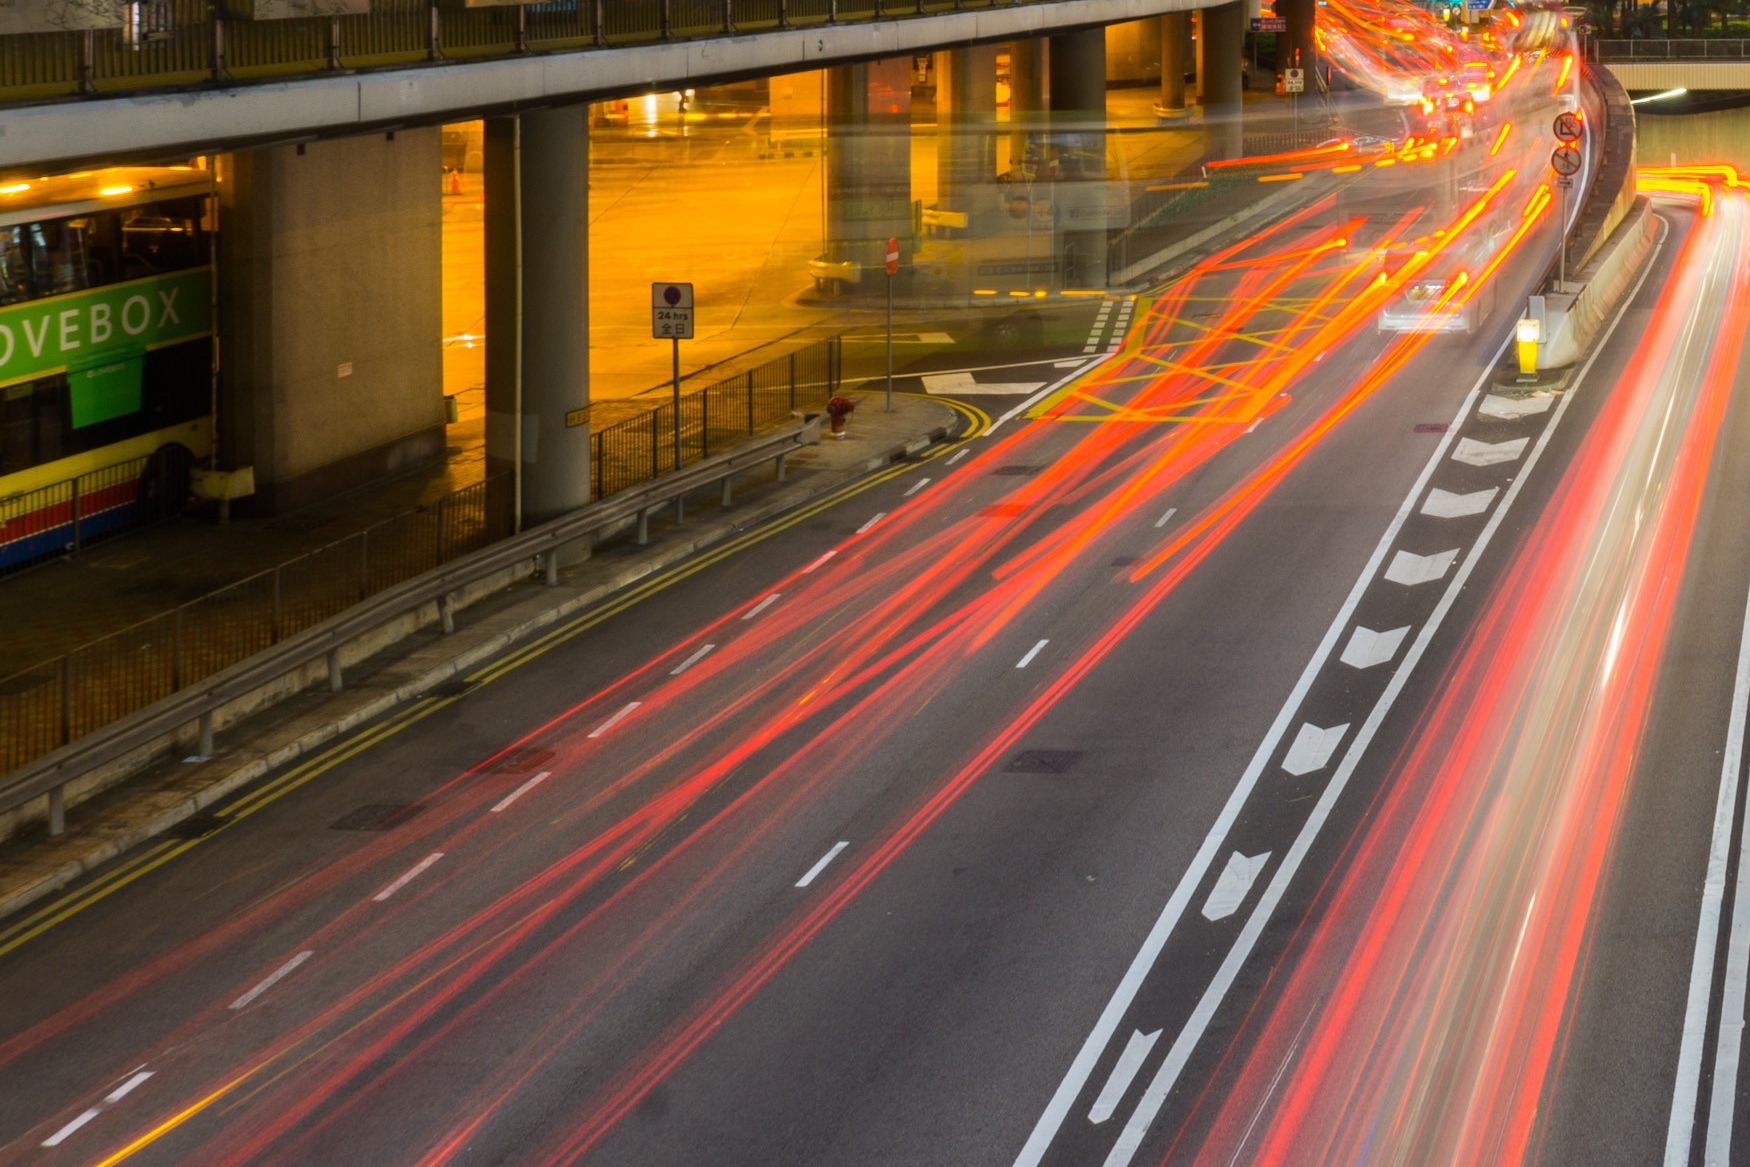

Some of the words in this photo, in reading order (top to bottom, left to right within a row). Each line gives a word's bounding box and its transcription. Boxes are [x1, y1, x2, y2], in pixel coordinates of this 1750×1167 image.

[658, 311, 671, 321] 24
[673, 311, 688, 321] hrs
[661, 323, 685, 335] 全日
